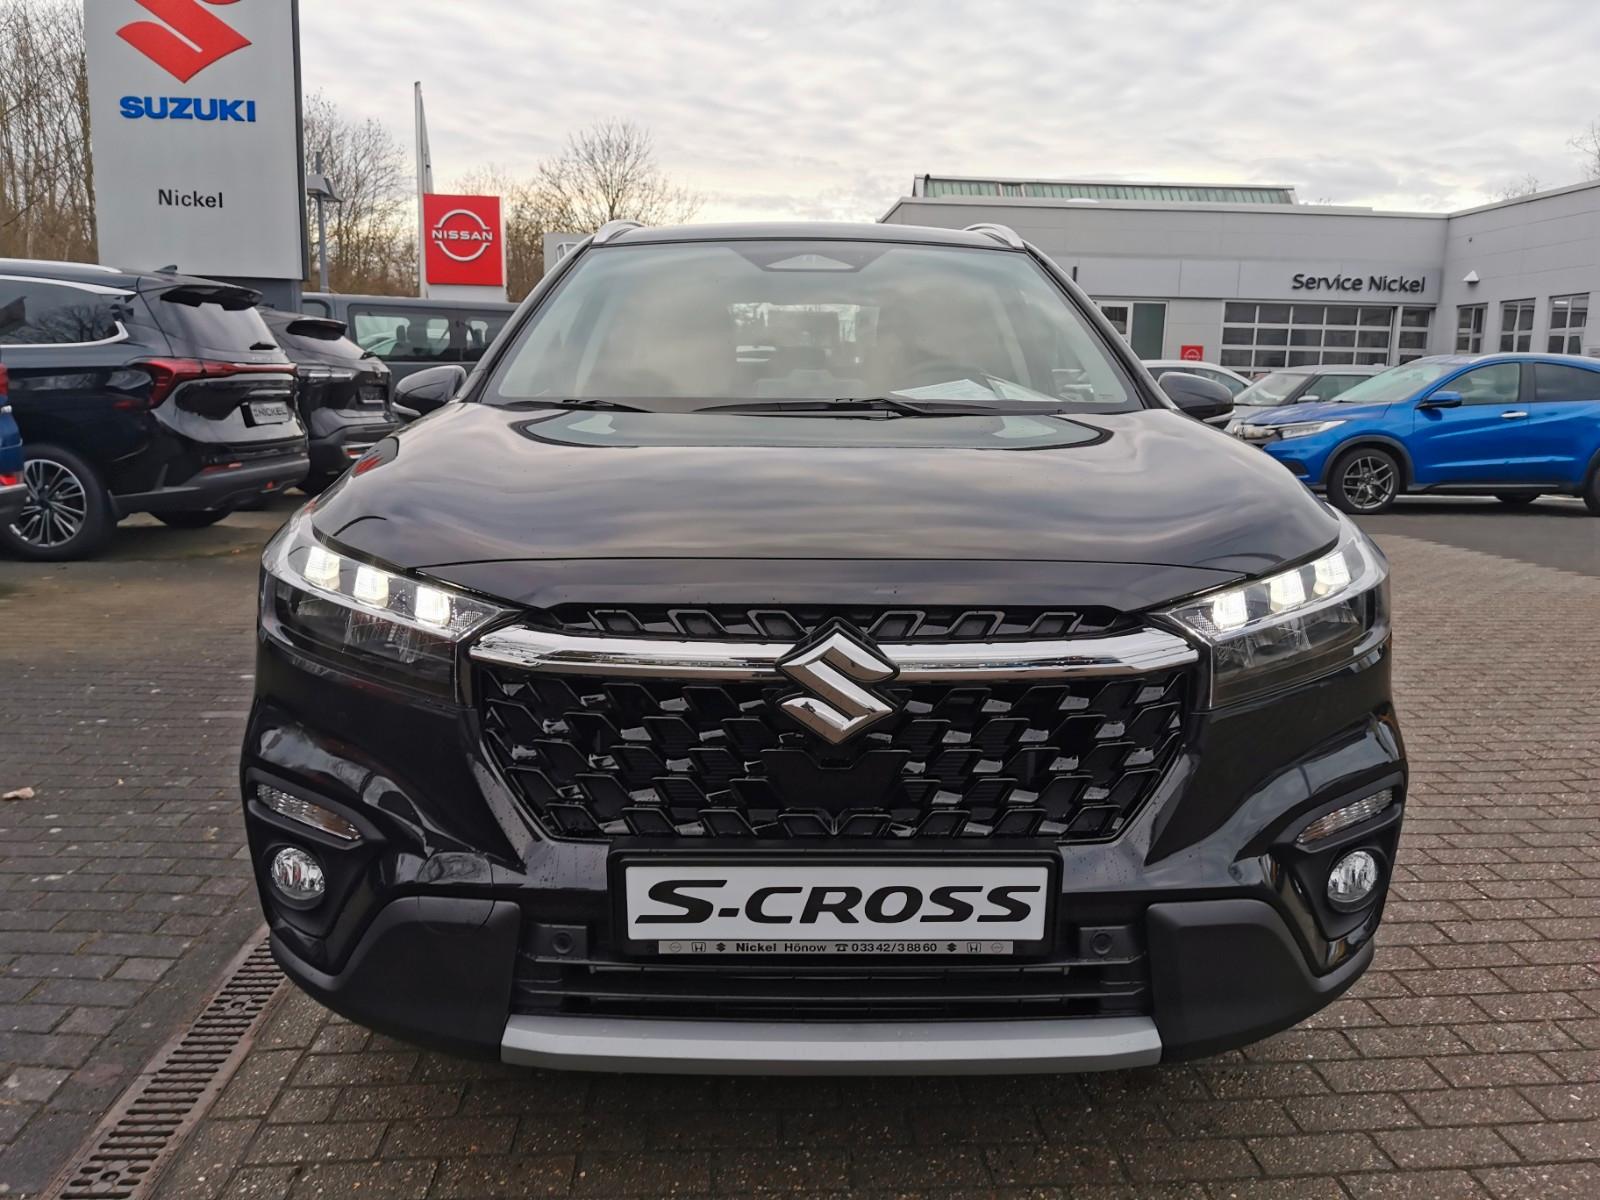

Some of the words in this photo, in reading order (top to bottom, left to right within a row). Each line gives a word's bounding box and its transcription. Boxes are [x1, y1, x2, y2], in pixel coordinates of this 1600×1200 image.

[119, 96, 257, 122] SUZUKI
[158, 188, 223, 209] Nickel
[432, 229, 493, 241] NISSAN
[1292, 273, 1363, 291] Service
[1368, 275, 1425, 293] Nickel
[634, 880, 1041, 924] S-CROSS
[735, 942, 777, 952] Nickel
[784, 942, 827, 952] Hönow
